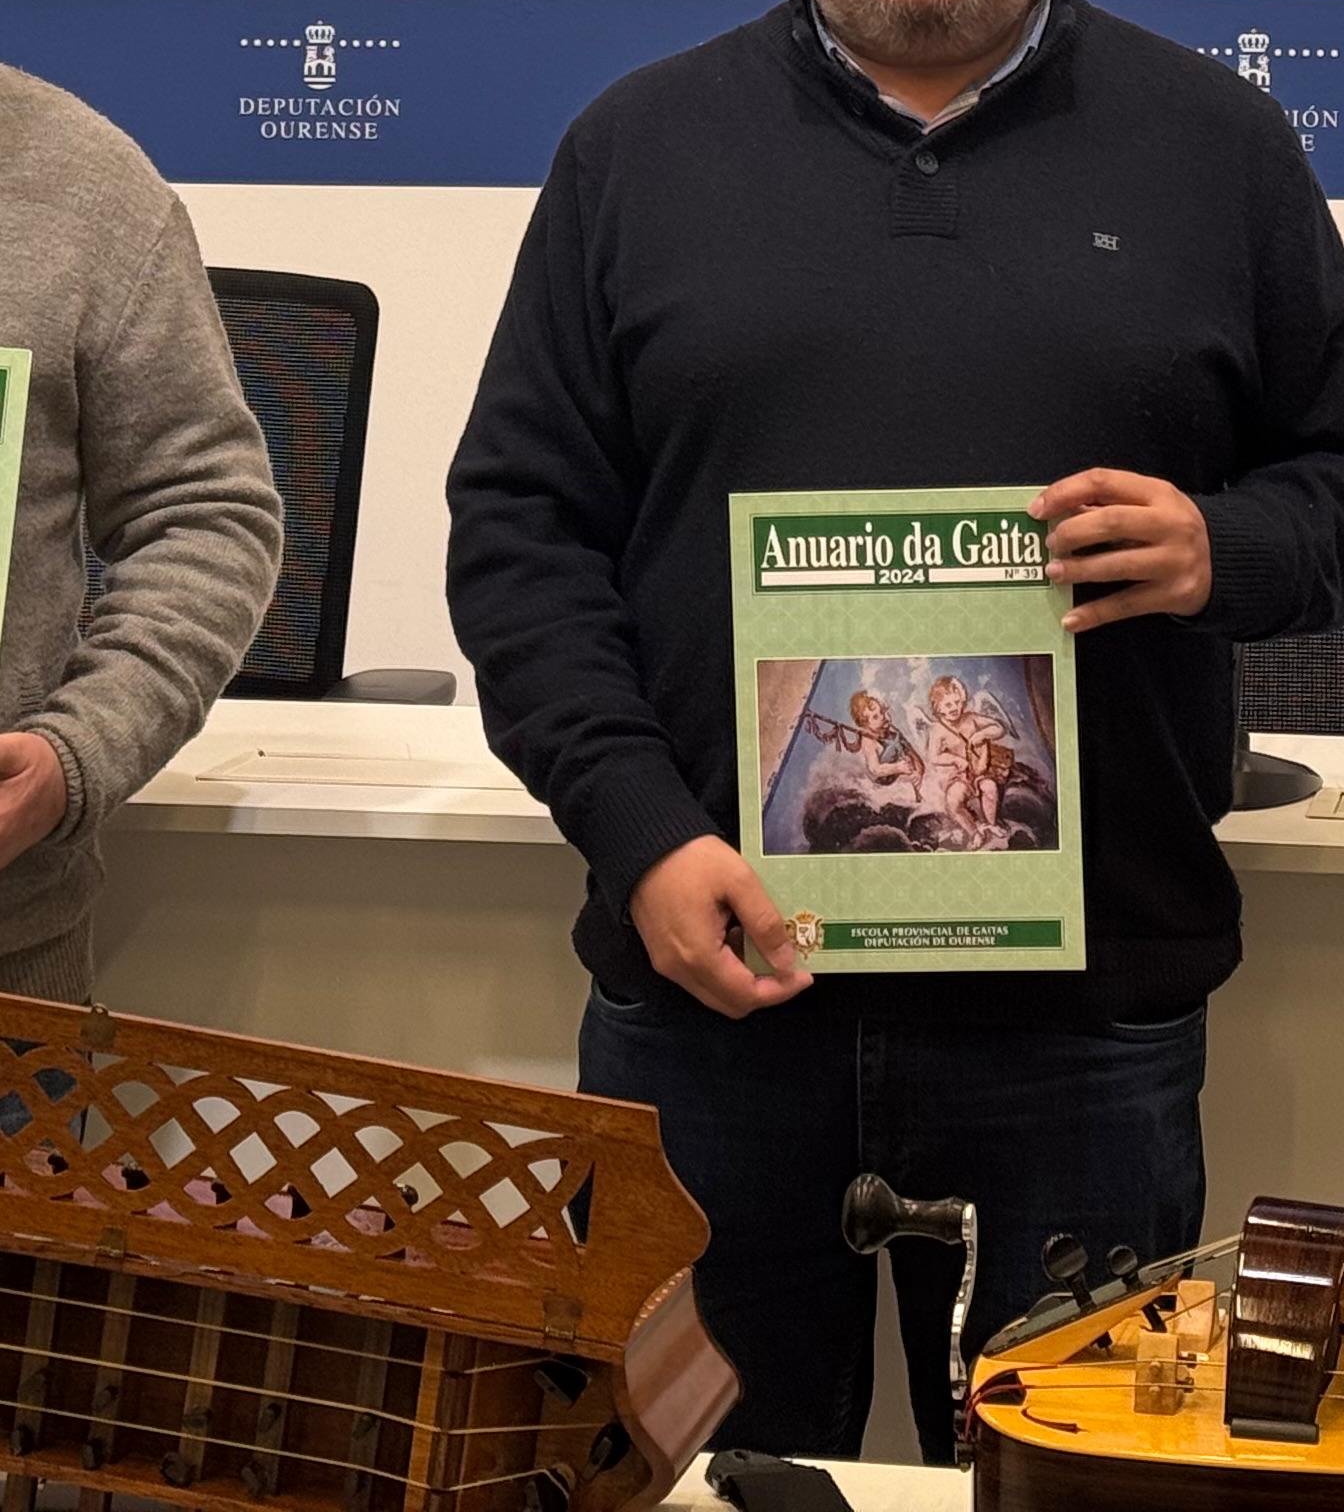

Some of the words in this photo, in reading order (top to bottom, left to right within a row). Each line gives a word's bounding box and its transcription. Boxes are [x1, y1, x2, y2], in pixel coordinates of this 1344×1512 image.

[238, 94, 400, 117] DEPUTACIÓN
[260, 120, 379, 140] OURENSE
[760, 521, 894, 569] Anuario
[903, 521, 944, 567] da
[952, 518, 1043, 566] Gaita
[878, 569, 926, 585] 2024
[1023, 568, 1039, 581] 39
[851, 927, 890, 938] ESCOLA
[892, 926, 954, 938] PROVINCIAL
[956, 926, 970, 936] DE
[972, 925, 1009, 936] GAITAS
[932, 936, 947, 947] DE
[948, 935, 996, 947] OURENSE
